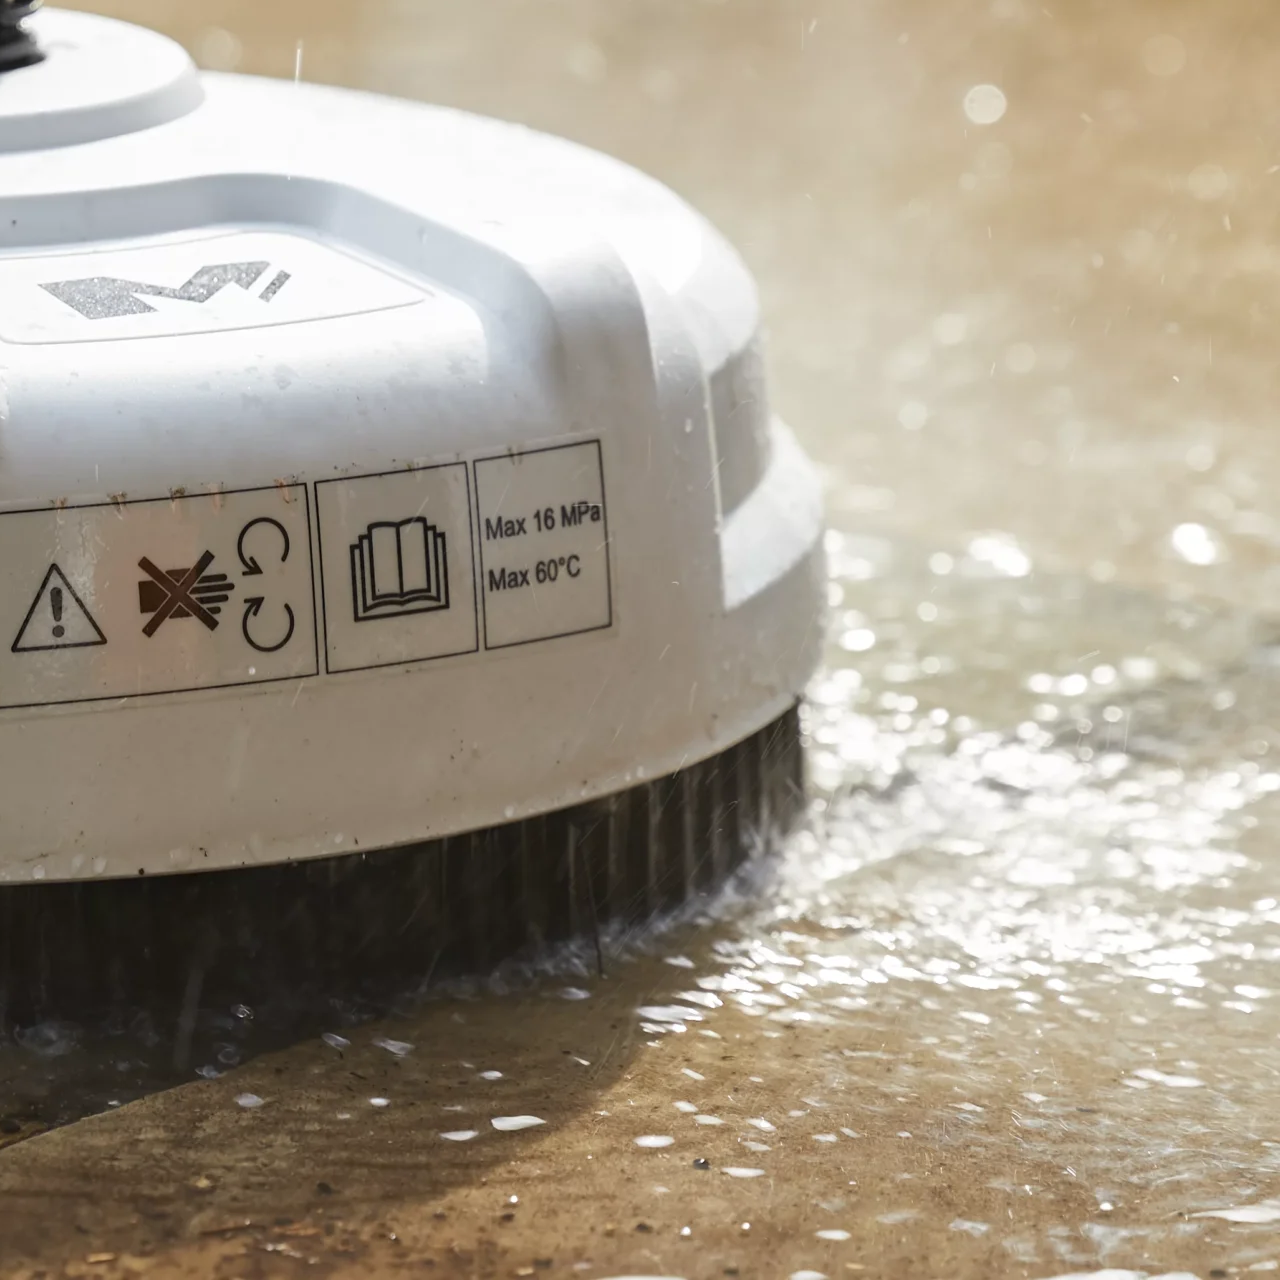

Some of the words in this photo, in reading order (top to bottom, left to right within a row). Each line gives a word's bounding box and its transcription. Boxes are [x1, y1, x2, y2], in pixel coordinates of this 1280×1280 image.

[485, 516, 527, 540] Max
[533, 507, 555, 532] 16
[560, 500, 601, 528] MPa
[488, 567, 530, 592] Max
